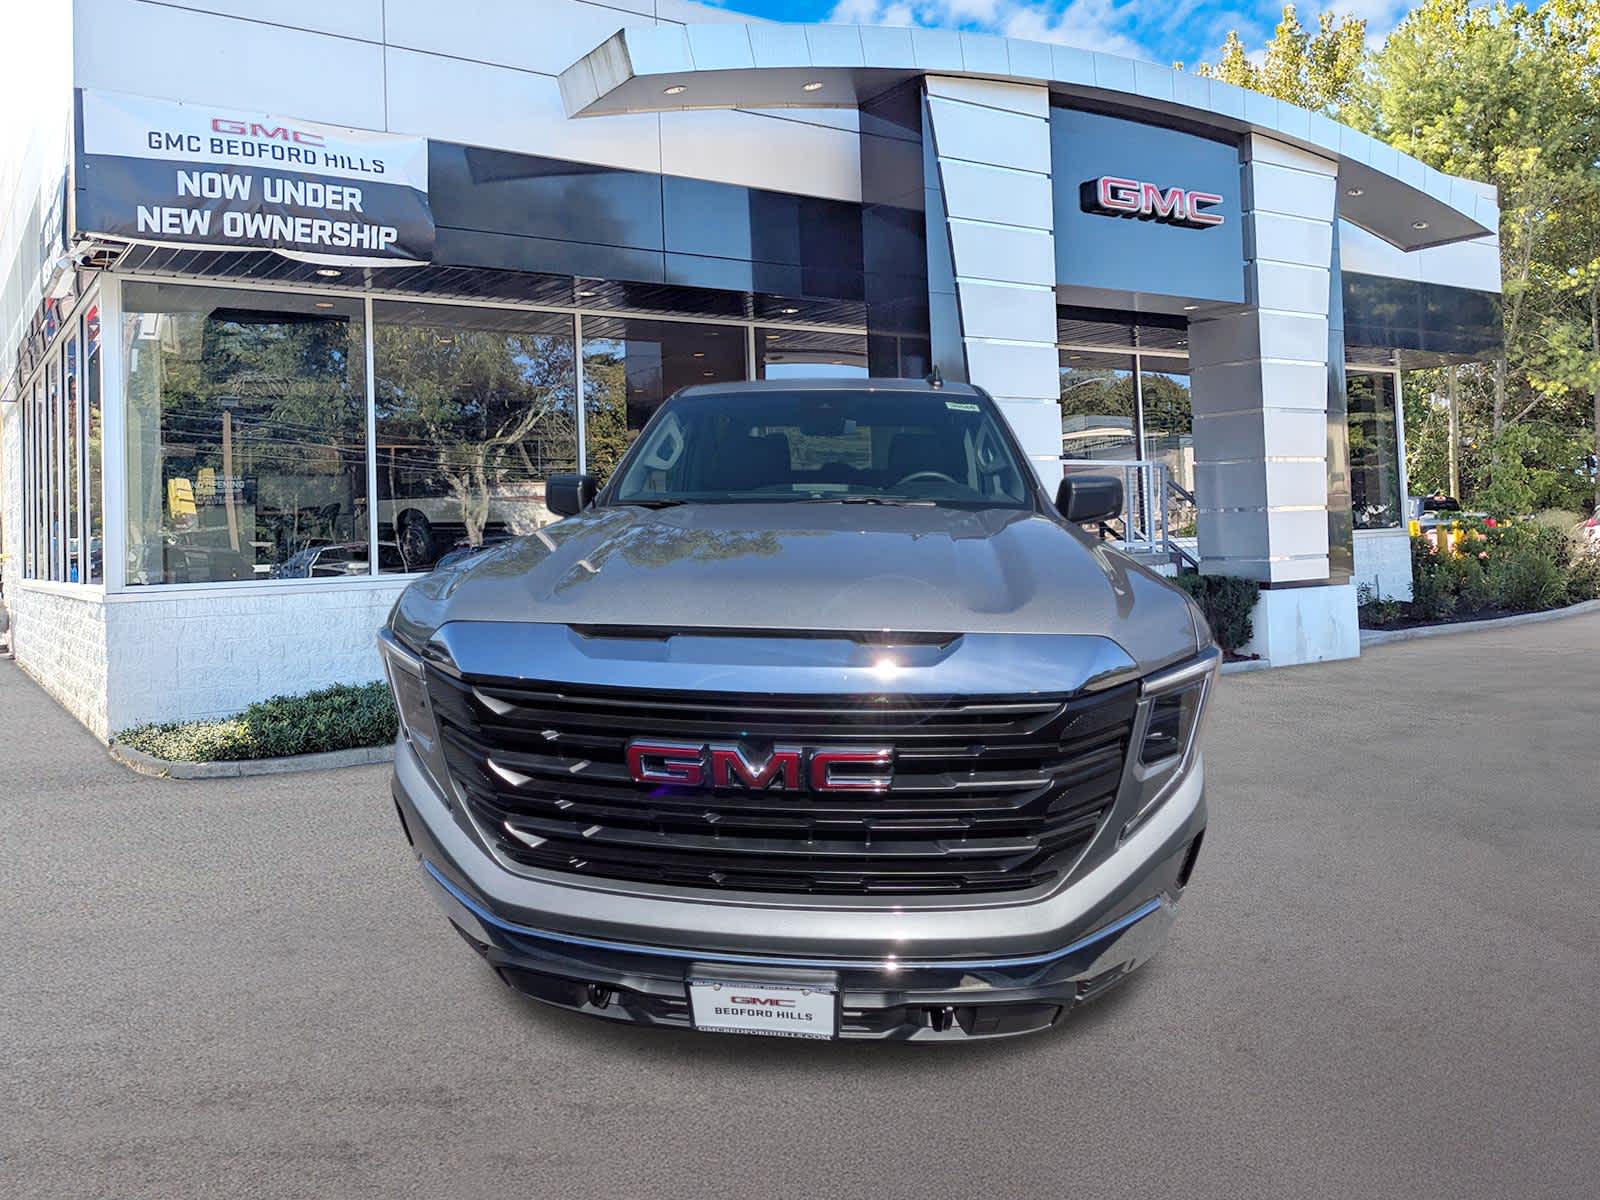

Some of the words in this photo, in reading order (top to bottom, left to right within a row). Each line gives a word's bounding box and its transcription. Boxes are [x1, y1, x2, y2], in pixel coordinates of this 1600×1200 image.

[148, 131, 201, 152] GMC
[210, 138, 317, 165] BEDFORD
[324, 153, 385, 174] HILLS
[211, 118, 325, 148] GMC
[176, 170, 252, 201] NOW
[263, 177, 364, 213] UNDER
[1097, 175, 1225, 225] GMC
[137, 205, 212, 236] NEW
[223, 211, 398, 250] OWNERSHIP
[625, 736, 895, 793] GMC
[714, 1007, 773, 1018] BEDFORD
[776, 1010, 813, 1021] HILLS
[730, 995, 797, 1009] GMC
